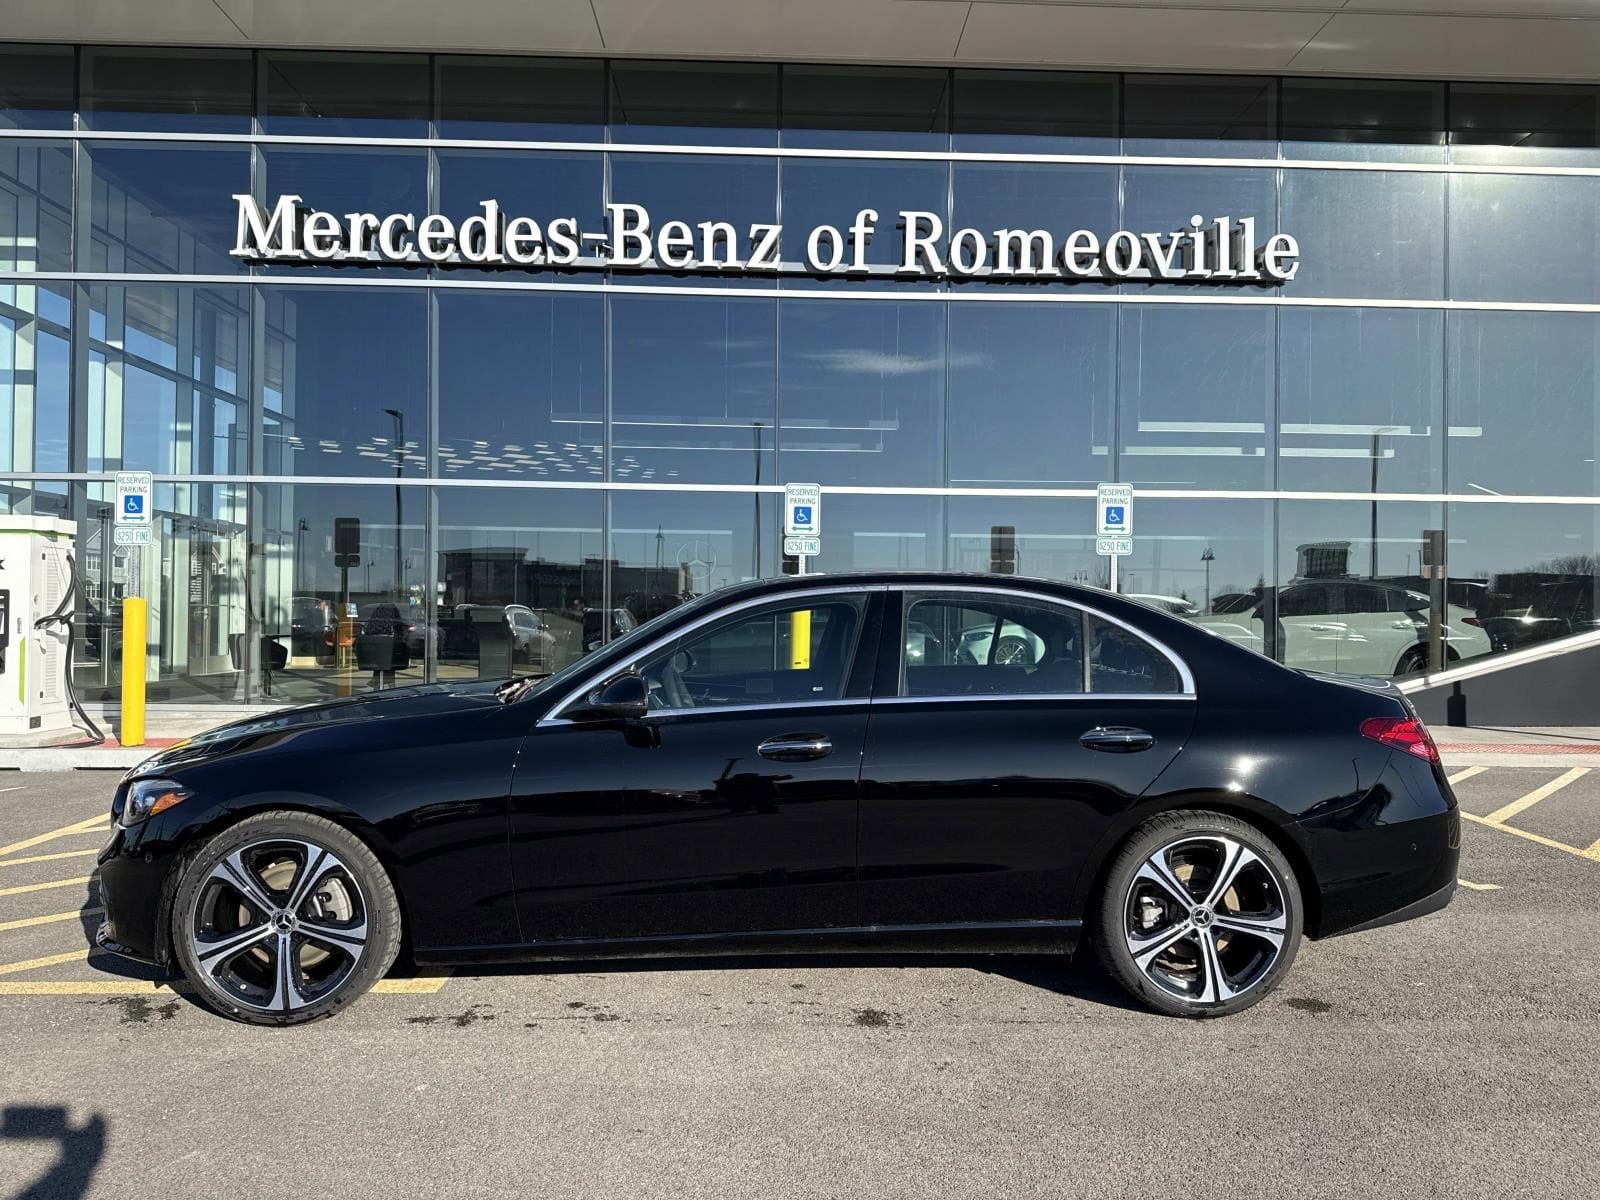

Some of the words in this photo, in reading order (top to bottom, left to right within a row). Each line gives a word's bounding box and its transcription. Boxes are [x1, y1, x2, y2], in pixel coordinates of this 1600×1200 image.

[229, 194, 782, 269] Mercedes-Benz
[807, 209, 878, 272] of
[899, 211, 1300, 279] Romeoville
[117, 476, 149, 485] RESERVED
[119, 485, 148, 493] PARKING
[787, 488, 818, 496] RESERVED
[1100, 488, 1131, 496] RESERVED
[789, 497, 816, 505] PARKING
[1101, 497, 1129, 505] PARKING
[117, 531, 133, 542] $250
[135, 531, 149, 542] FINE
[787, 541, 803, 552] $250
[804, 541, 817, 552] FINE
[1099, 541, 1115, 551] $250
[1116, 541, 1130, 551] FINE
